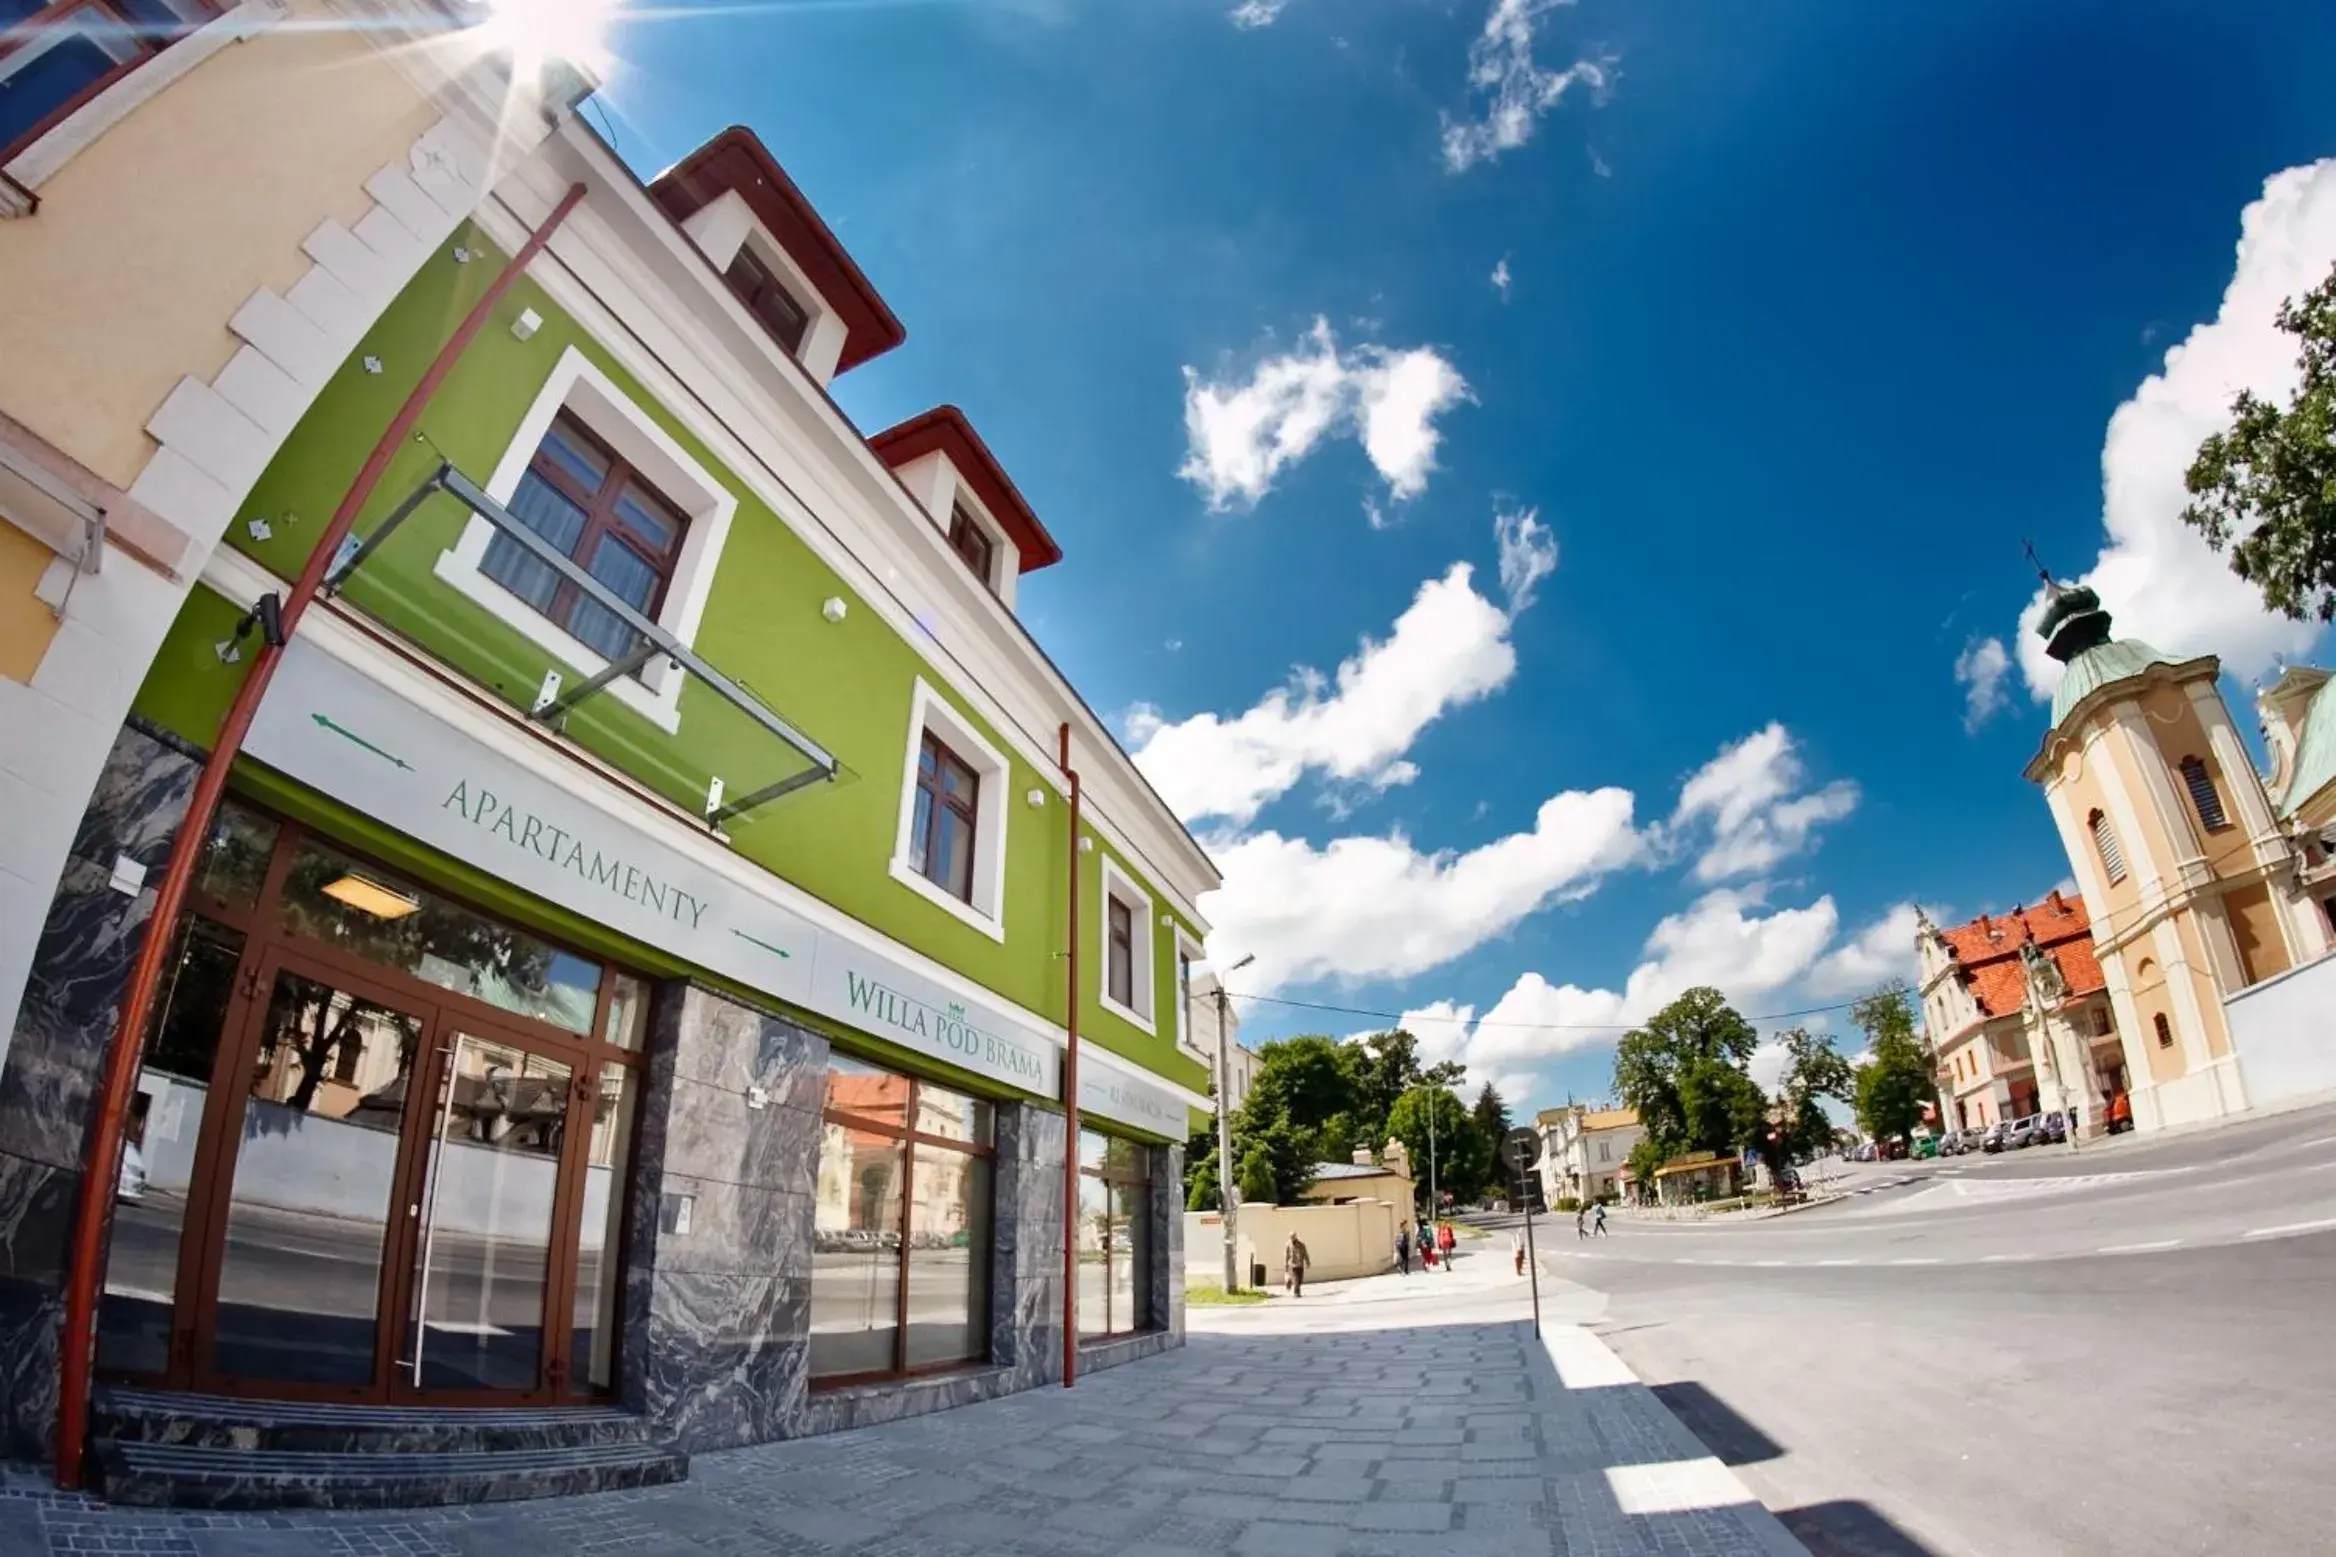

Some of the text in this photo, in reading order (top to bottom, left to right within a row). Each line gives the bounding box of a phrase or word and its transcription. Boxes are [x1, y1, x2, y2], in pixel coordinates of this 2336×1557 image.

[441, 778, 708, 930] APARTAMENTY
[847, 970, 927, 1036] WILLA
[935, 1015, 979, 1055] POD
